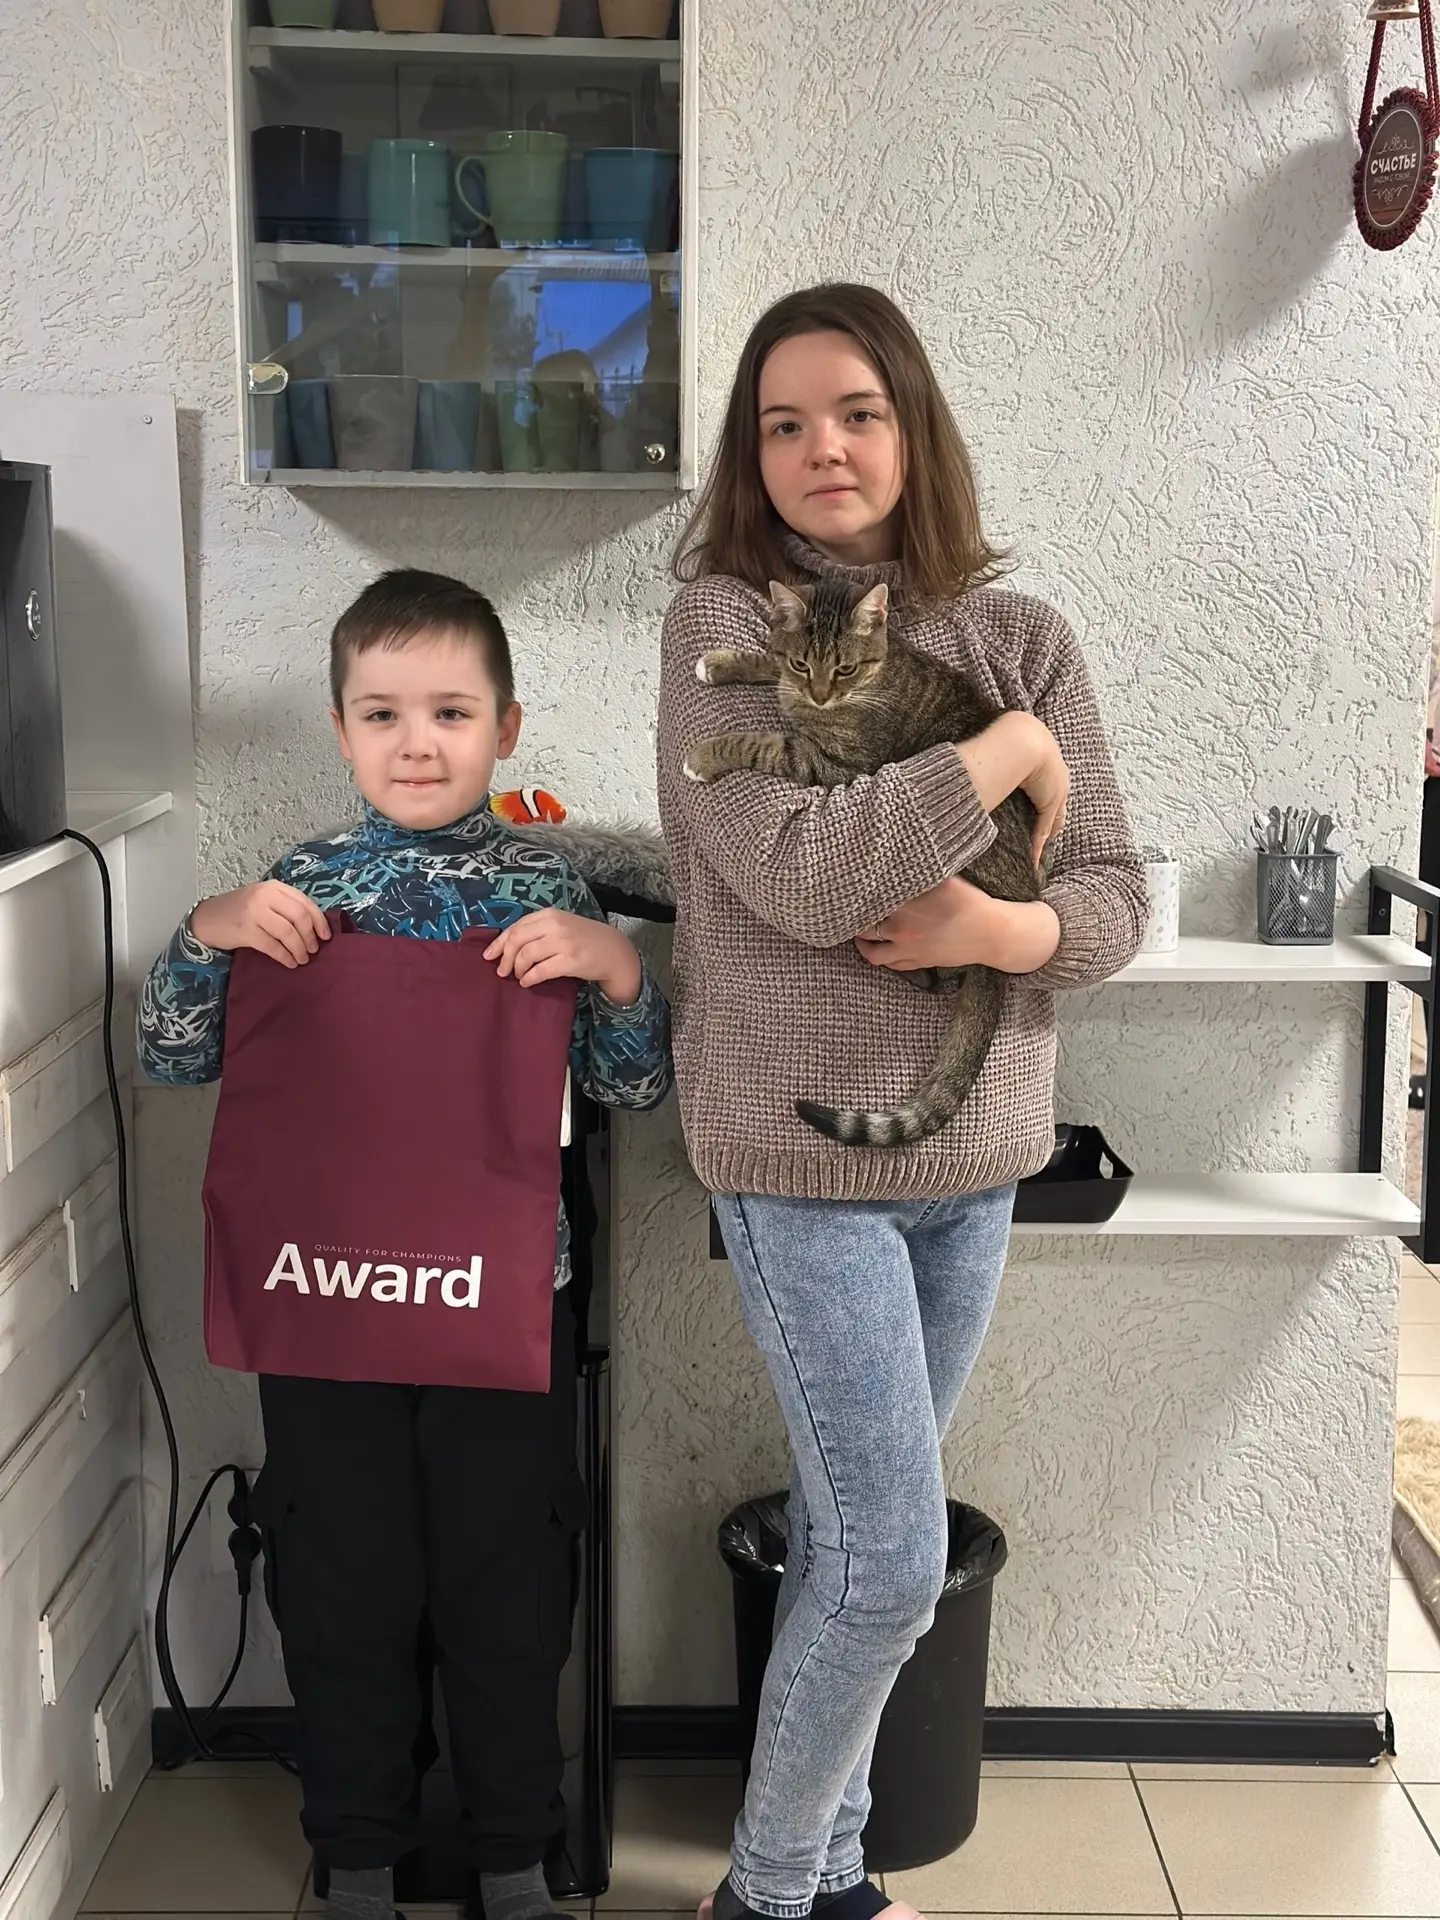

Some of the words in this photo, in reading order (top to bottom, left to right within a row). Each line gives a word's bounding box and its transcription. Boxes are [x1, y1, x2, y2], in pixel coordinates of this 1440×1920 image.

[1370, 153, 1417, 175] СЧАСТЬЕ
[314, 1243, 360, 1255] QUALITY
[365, 1248, 388, 1257] FOR
[392, 1250, 462, 1263] CHAMPIONS
[263, 1242, 483, 1309] Award
